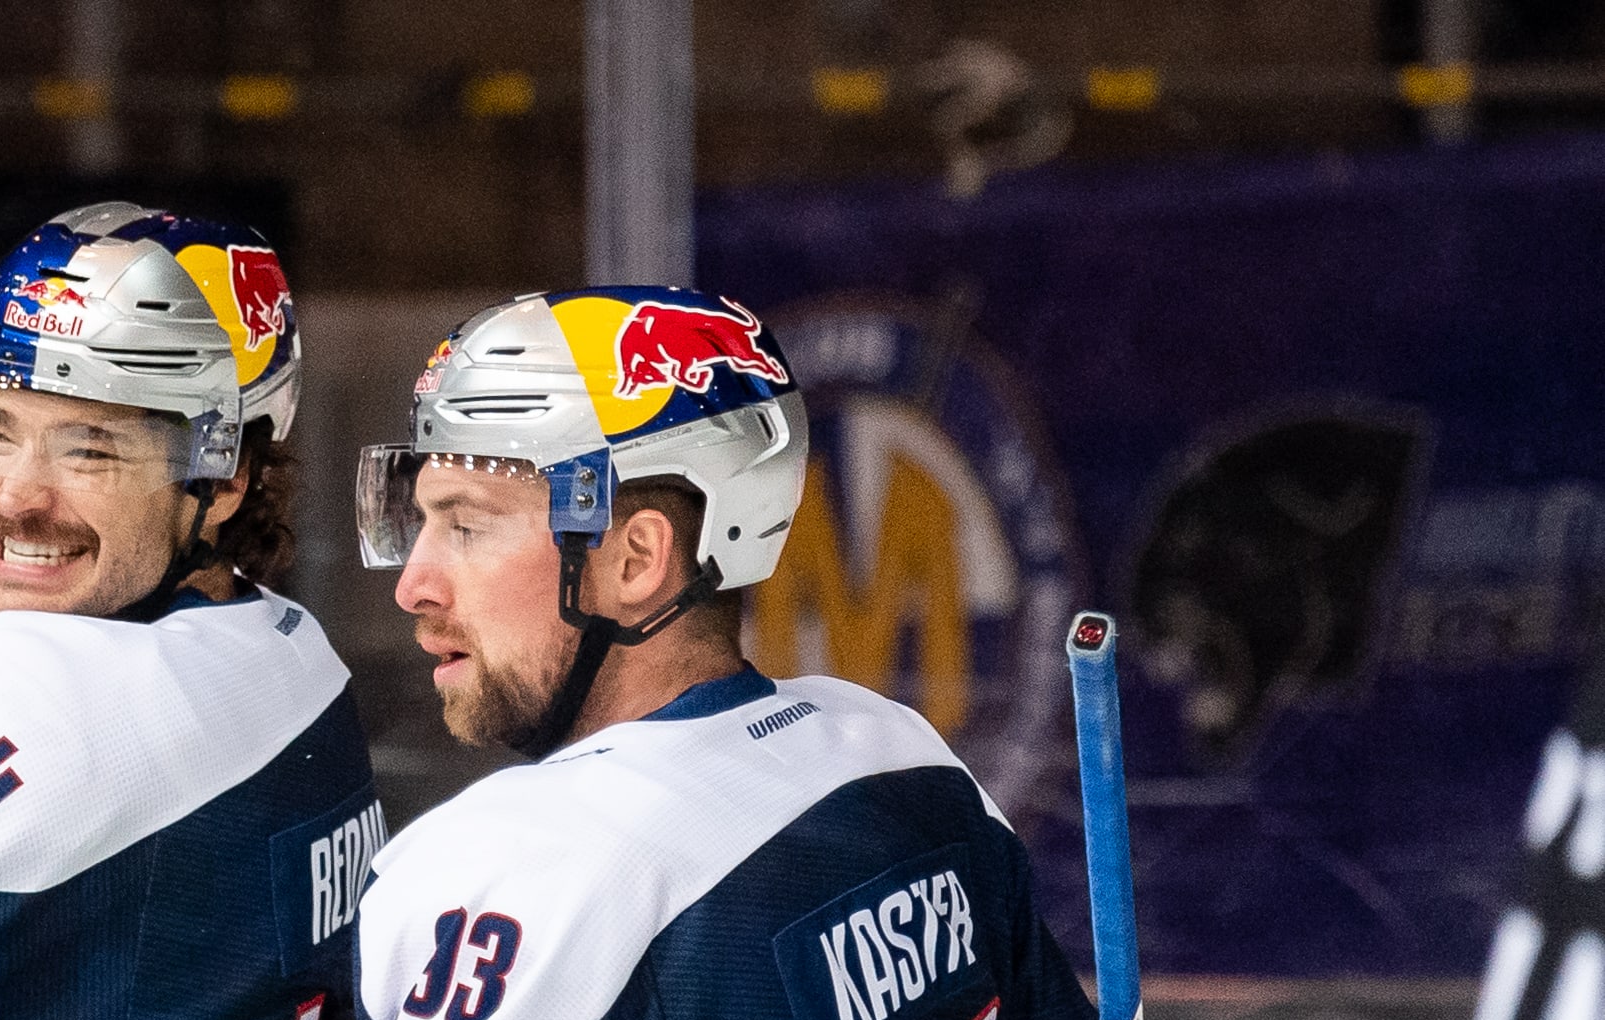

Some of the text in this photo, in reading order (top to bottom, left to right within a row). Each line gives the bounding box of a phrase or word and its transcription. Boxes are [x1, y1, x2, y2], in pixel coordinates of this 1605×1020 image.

[3, 301, 84, 337] Red Bull
[746, 702, 822, 740] WARRIOR
